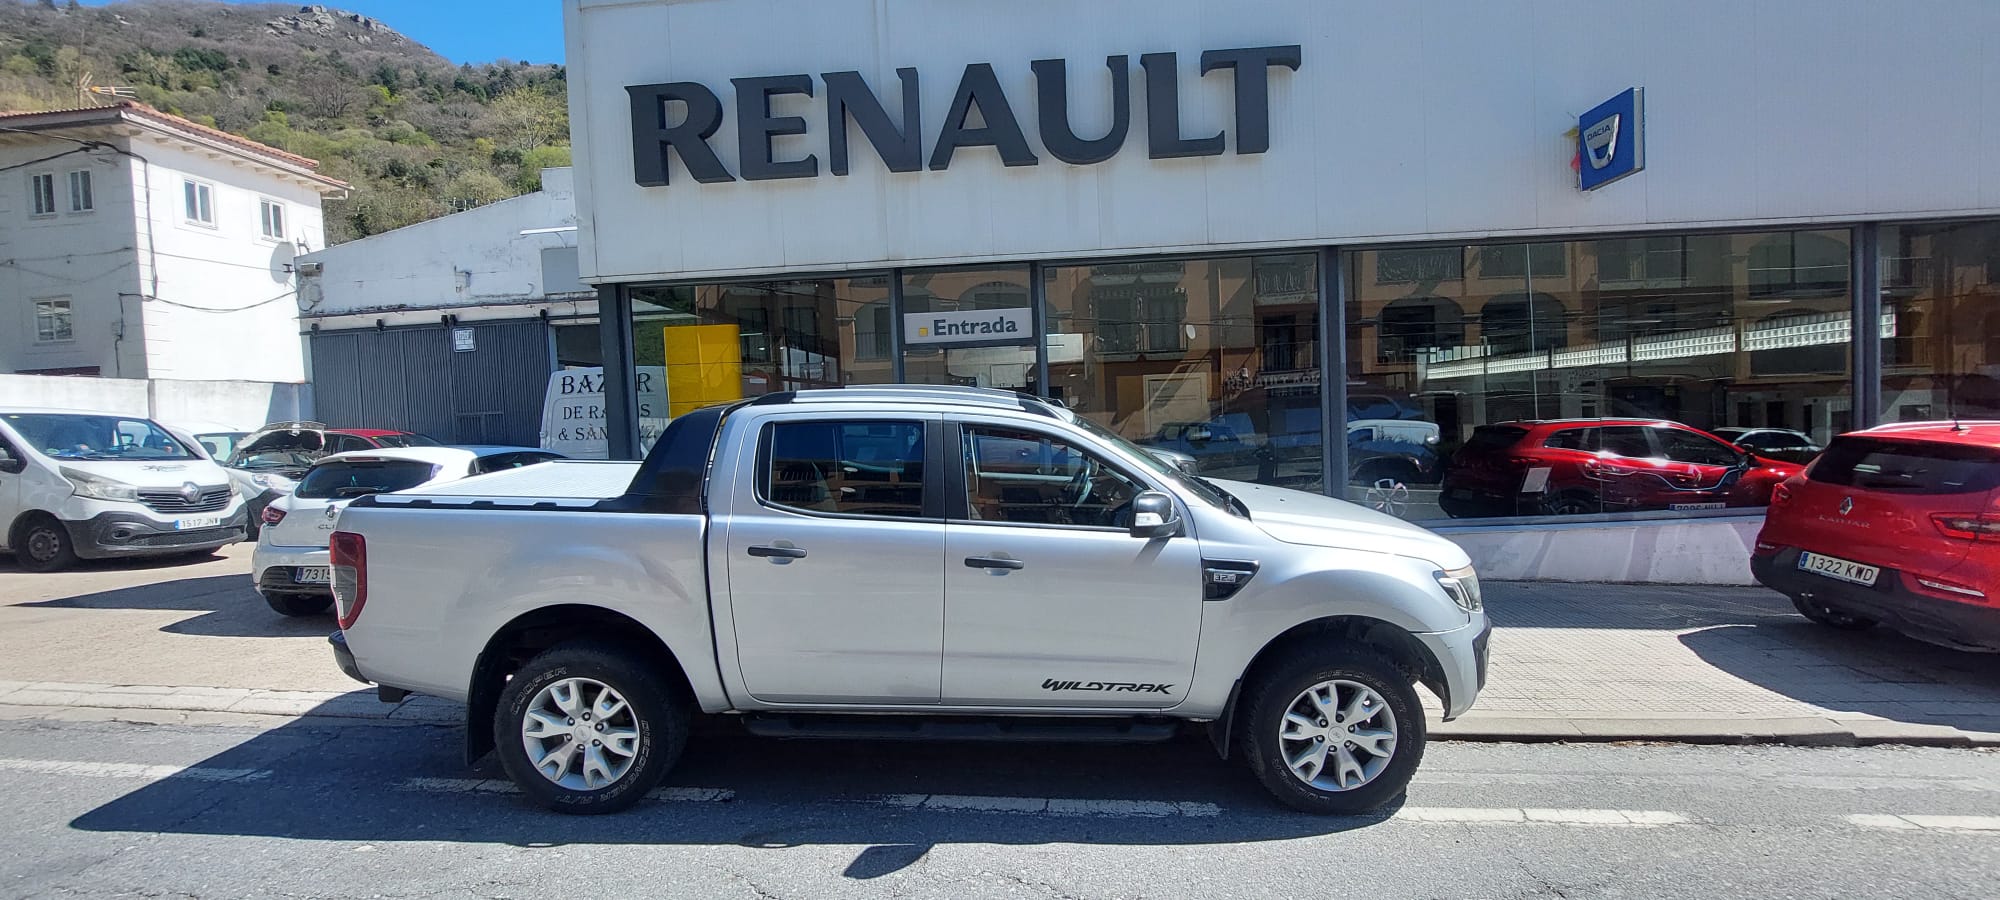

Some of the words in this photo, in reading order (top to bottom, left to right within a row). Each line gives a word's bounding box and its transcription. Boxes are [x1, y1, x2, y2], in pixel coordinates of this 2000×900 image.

[624, 44, 1303, 188] RENAULT
[1587, 124, 1611, 141] DACIA
[933, 316, 1018, 336] Entrada
[561, 372, 651, 395] BAZR
[563, 406, 583, 420] DE
[559, 427, 570, 440] &
[182, 519, 202, 528] 1517
[304, 568, 331, 580] 7315
[1810, 556, 1842, 574] 1322
[1845, 563, 1874, 581] KWD
[1041, 678, 1177, 695] WILDTRAK
